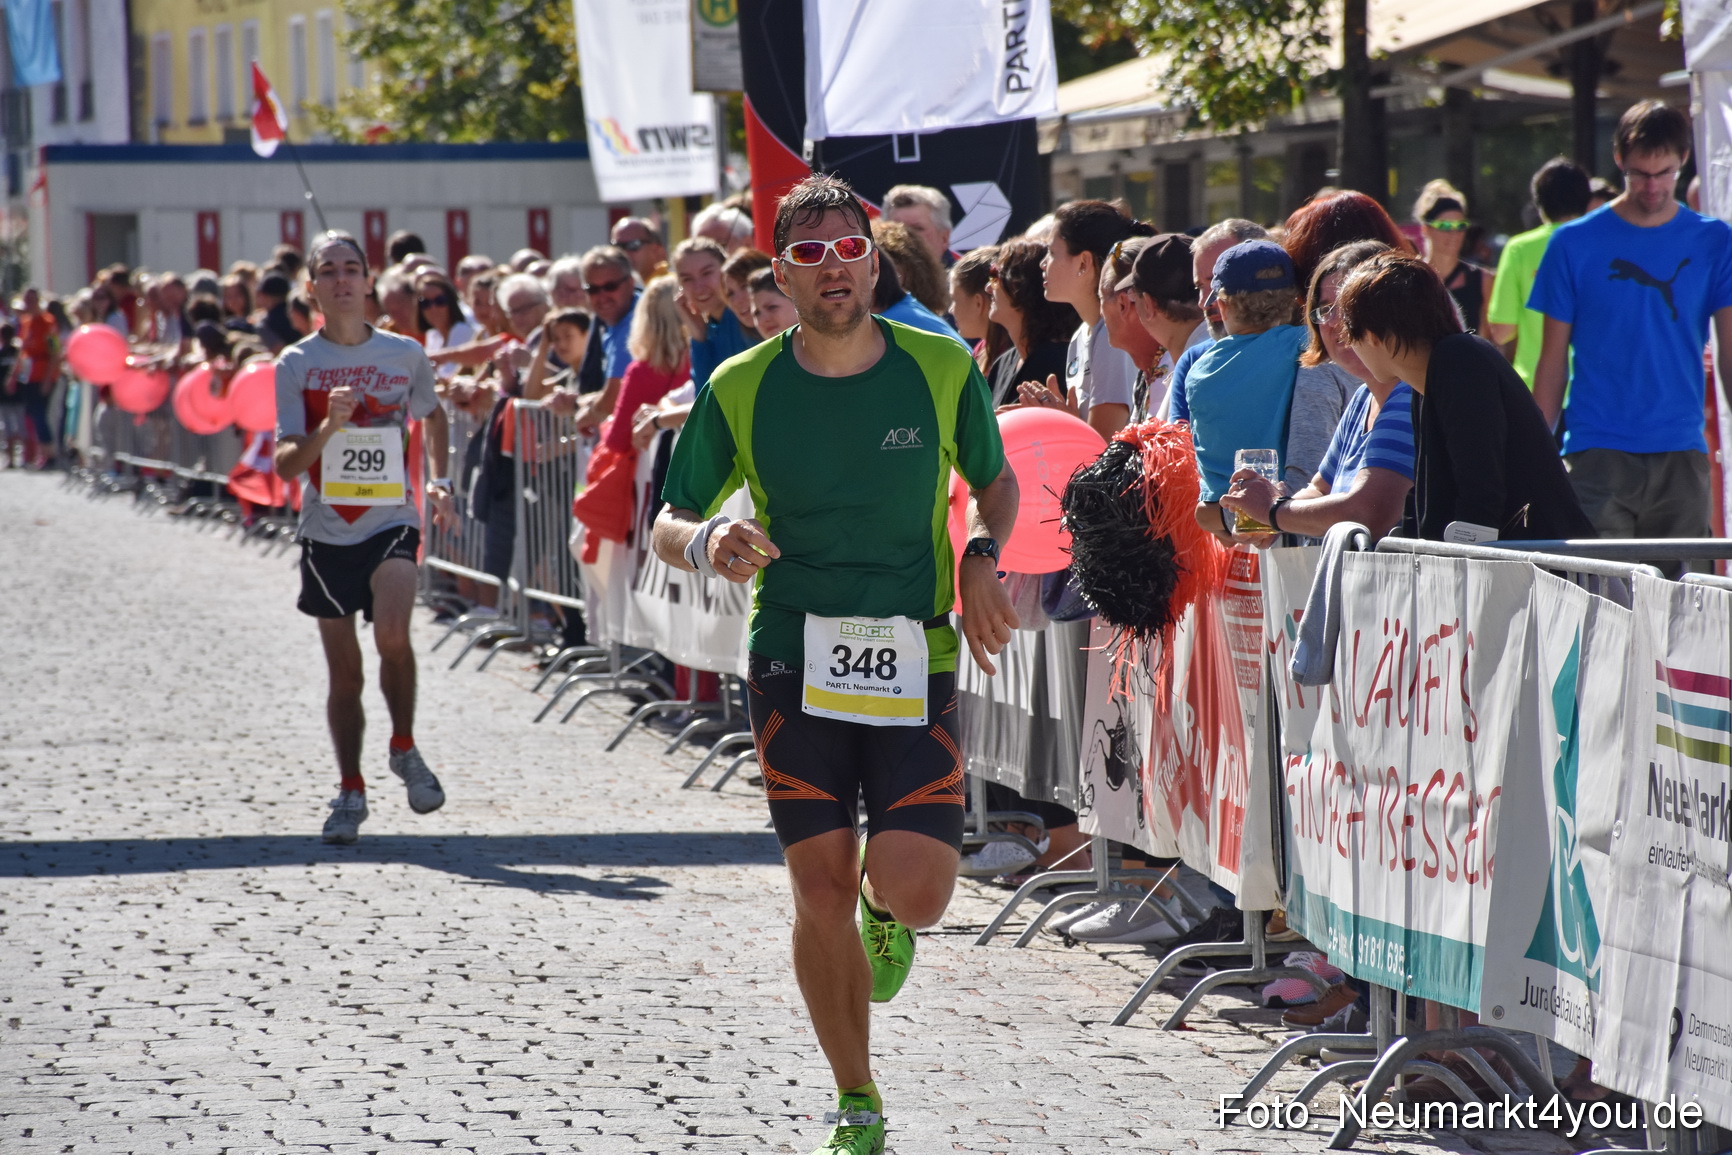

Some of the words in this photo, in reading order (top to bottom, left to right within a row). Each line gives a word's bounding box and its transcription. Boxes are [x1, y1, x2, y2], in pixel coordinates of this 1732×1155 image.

[882, 427, 922, 446] AOK
[343, 449, 386, 472] 299
[355, 486, 373, 496] Jan
[840, 621, 895, 639] BOCK
[829, 644, 897, 681] 348
[825, 680, 852, 690] PARTL
[853, 683, 890, 693] Neumarkt
[1520, 976, 1549, 1012] Jura
[1684, 1046, 1725, 1080] Neumarkt
